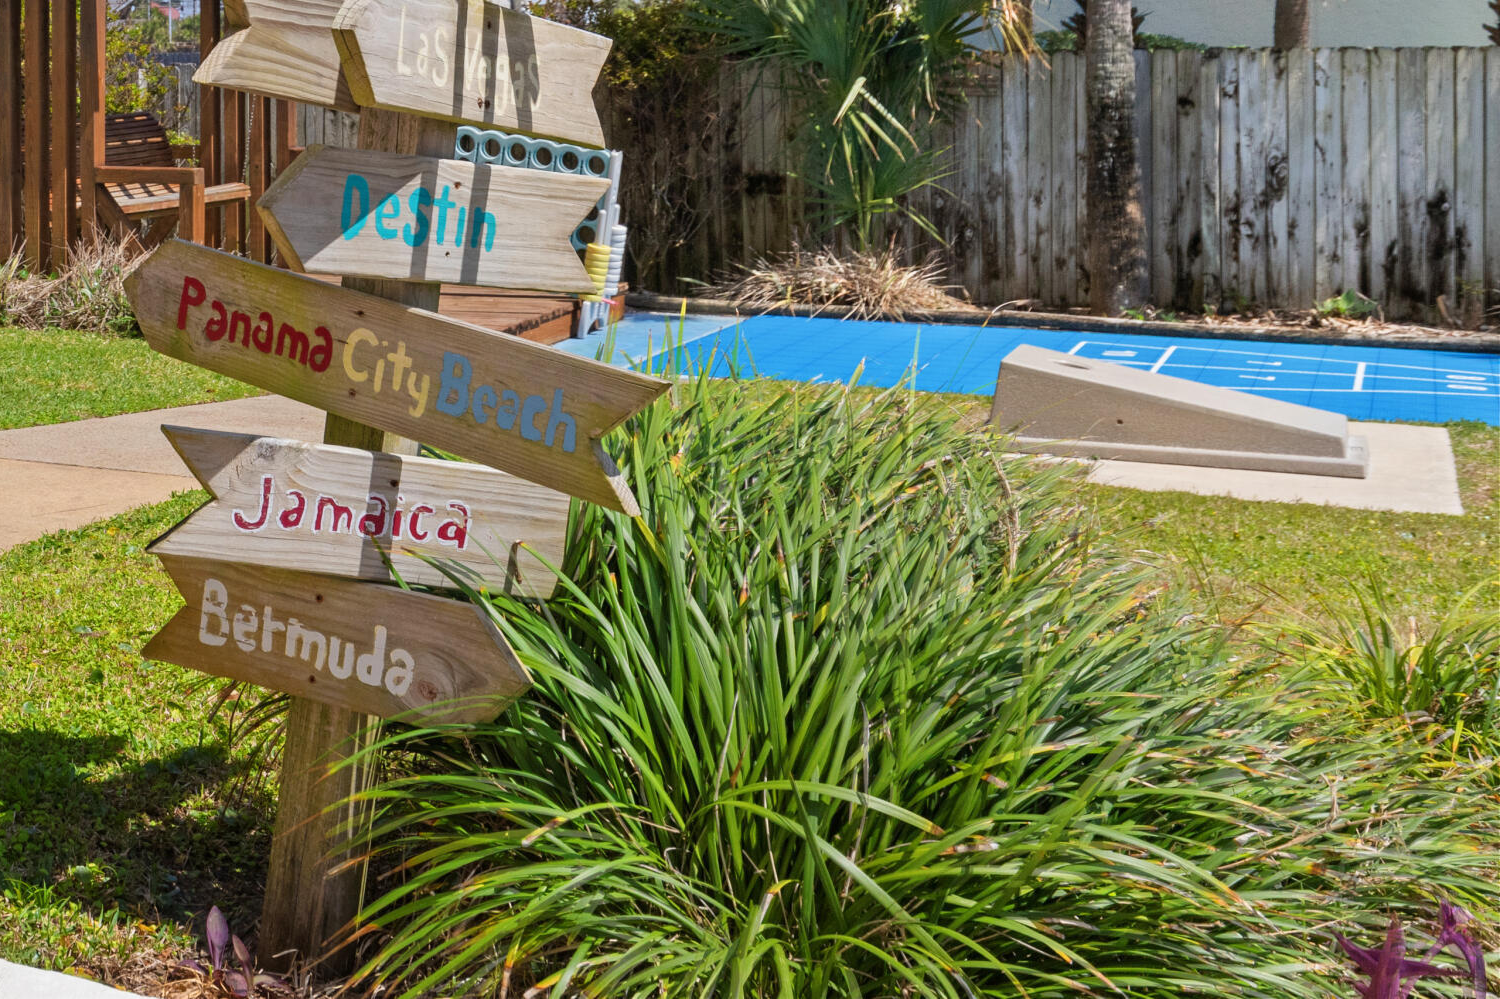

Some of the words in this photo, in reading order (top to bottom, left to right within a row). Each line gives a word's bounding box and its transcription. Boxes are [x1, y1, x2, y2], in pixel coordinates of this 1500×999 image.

[339, 174, 497, 253] Destin
[177, 276, 334, 373] Panama
[342, 328, 431, 417] City
[436, 351, 578, 453] Beach
[230, 474, 472, 551] Jamaica
[199, 578, 416, 696] Bermuda
